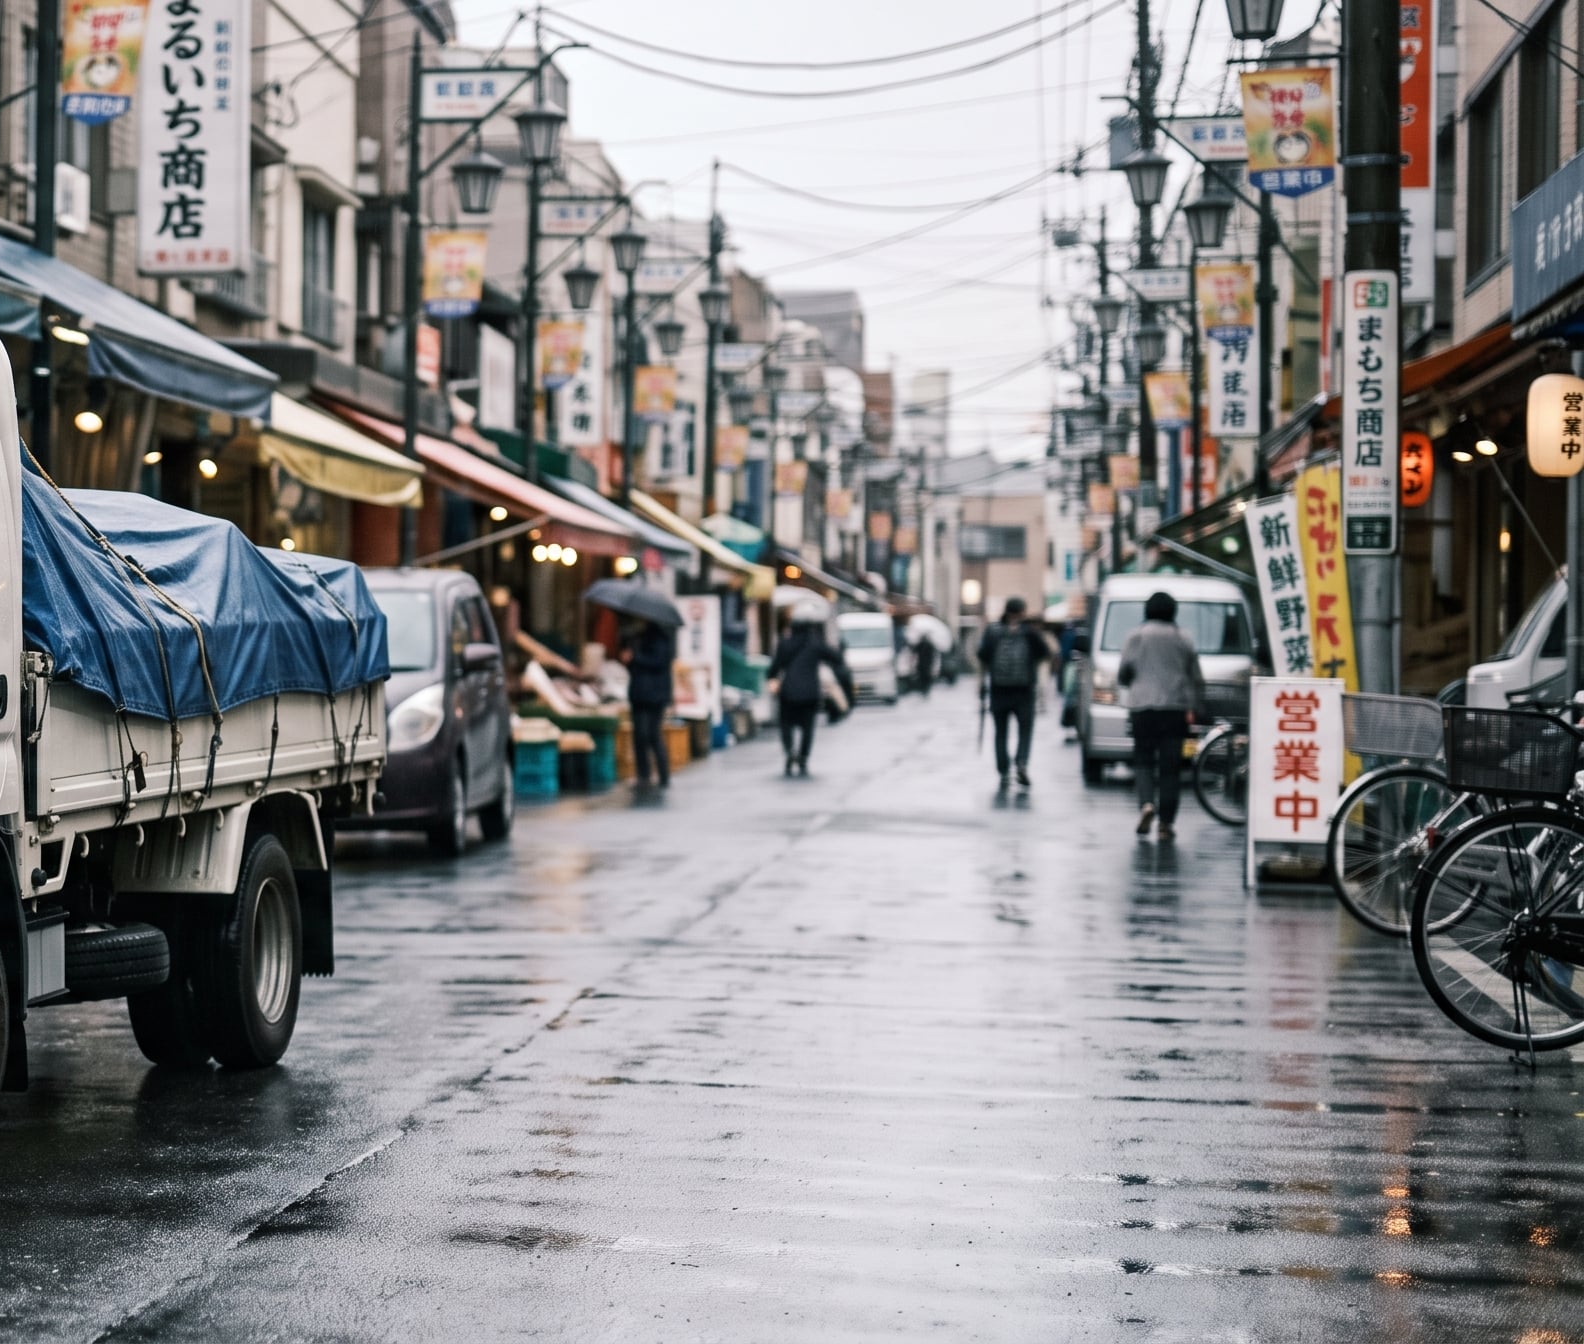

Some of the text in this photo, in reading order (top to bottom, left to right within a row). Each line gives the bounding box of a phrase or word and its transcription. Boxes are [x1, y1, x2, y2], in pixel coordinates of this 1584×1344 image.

[1561, 392, 1584, 460] 営業中
[1259, 511, 1312, 673] 新鮮野菜
[1273, 690, 1321, 833] 営業中
